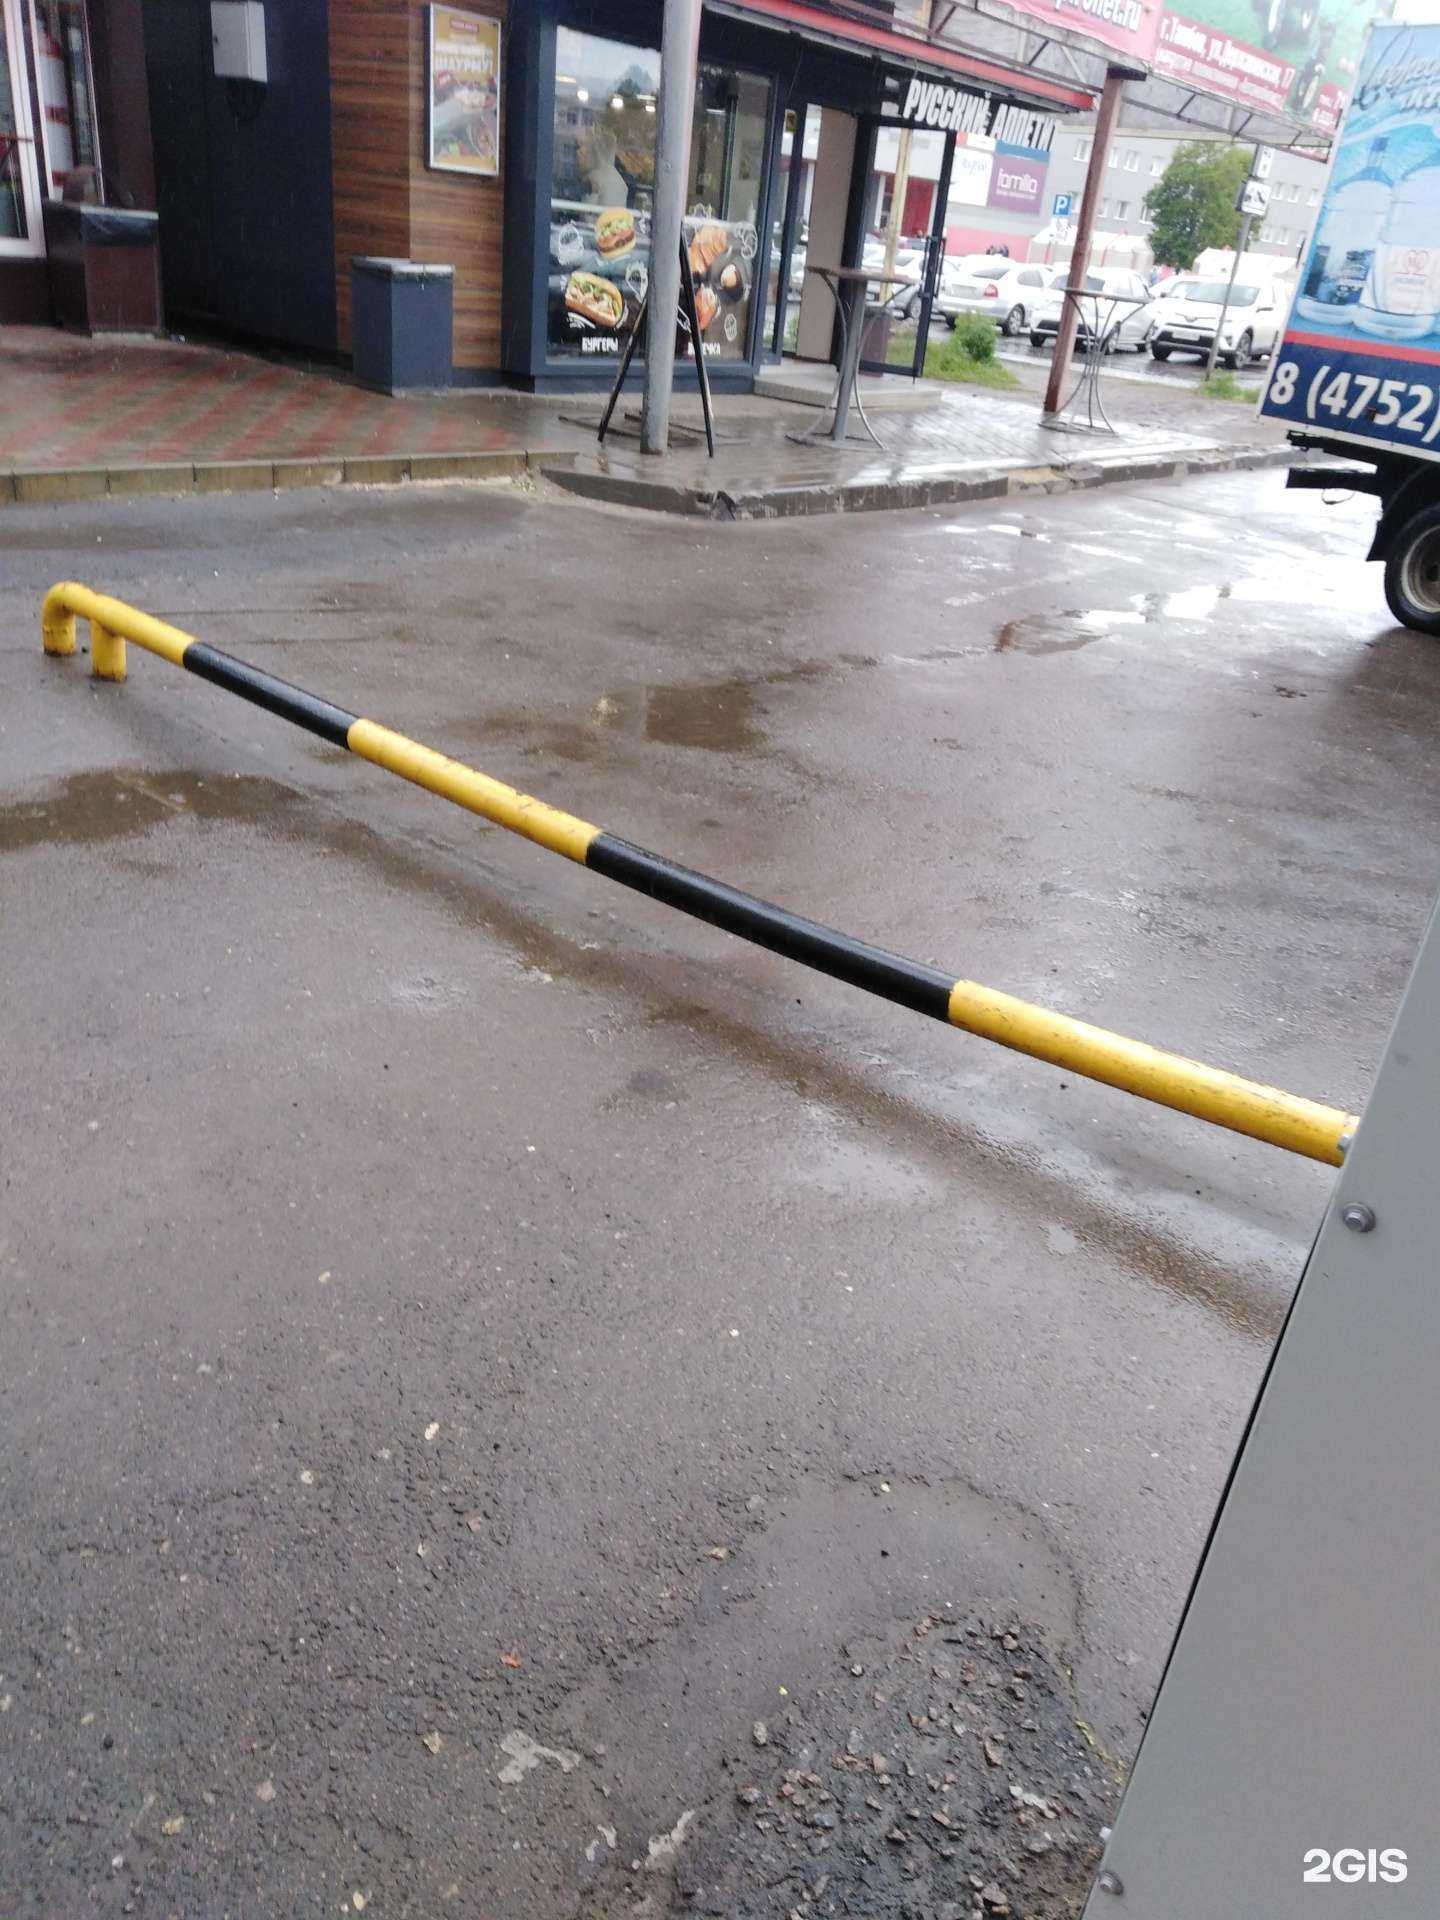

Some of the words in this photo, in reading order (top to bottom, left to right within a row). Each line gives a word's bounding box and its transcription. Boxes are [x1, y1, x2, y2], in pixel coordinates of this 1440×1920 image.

[903, 78, 992, 138] РУССКИЙ
[1055, 195, 1069, 214] P
[581, 336, 619, 352] БУРГЕРЫ
[687, 341, 721, 356] ВЕЧКА
[1269, 361, 1300, 405] 8
[1306, 365, 1440, 443] (4752)
